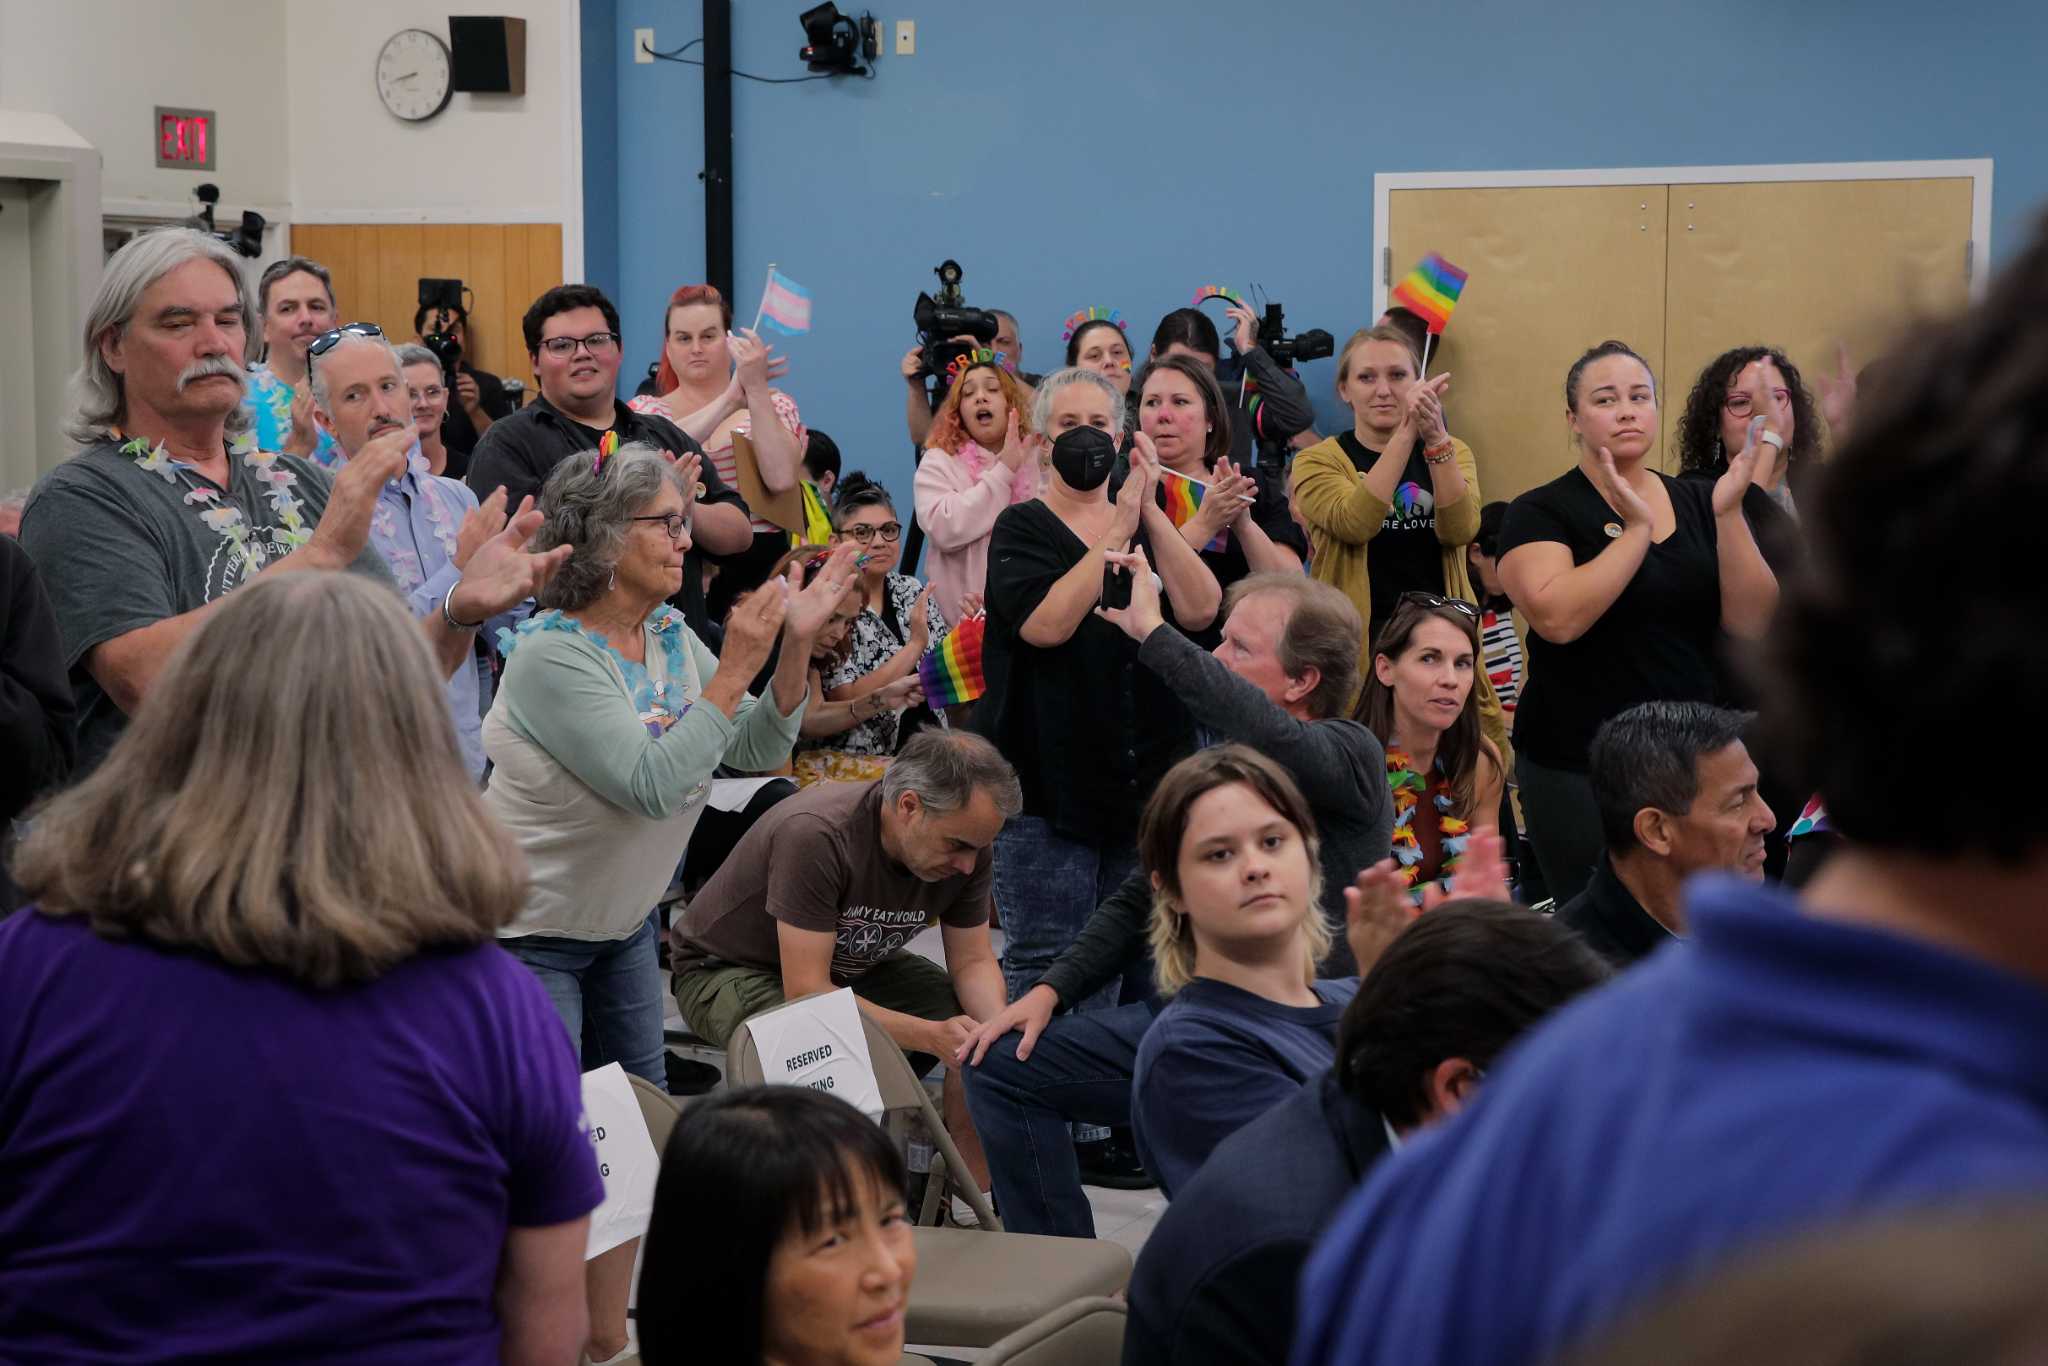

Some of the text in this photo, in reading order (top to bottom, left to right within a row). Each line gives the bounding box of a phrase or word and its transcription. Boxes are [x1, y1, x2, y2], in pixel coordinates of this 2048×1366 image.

[160, 114, 209, 164] EXIT
[945, 348, 1009, 376] PRIDE
[1403, 519, 1436, 530] LOVE
[873, 908, 895, 923] EAT
[786, 1044, 832, 1073] RESERVED
